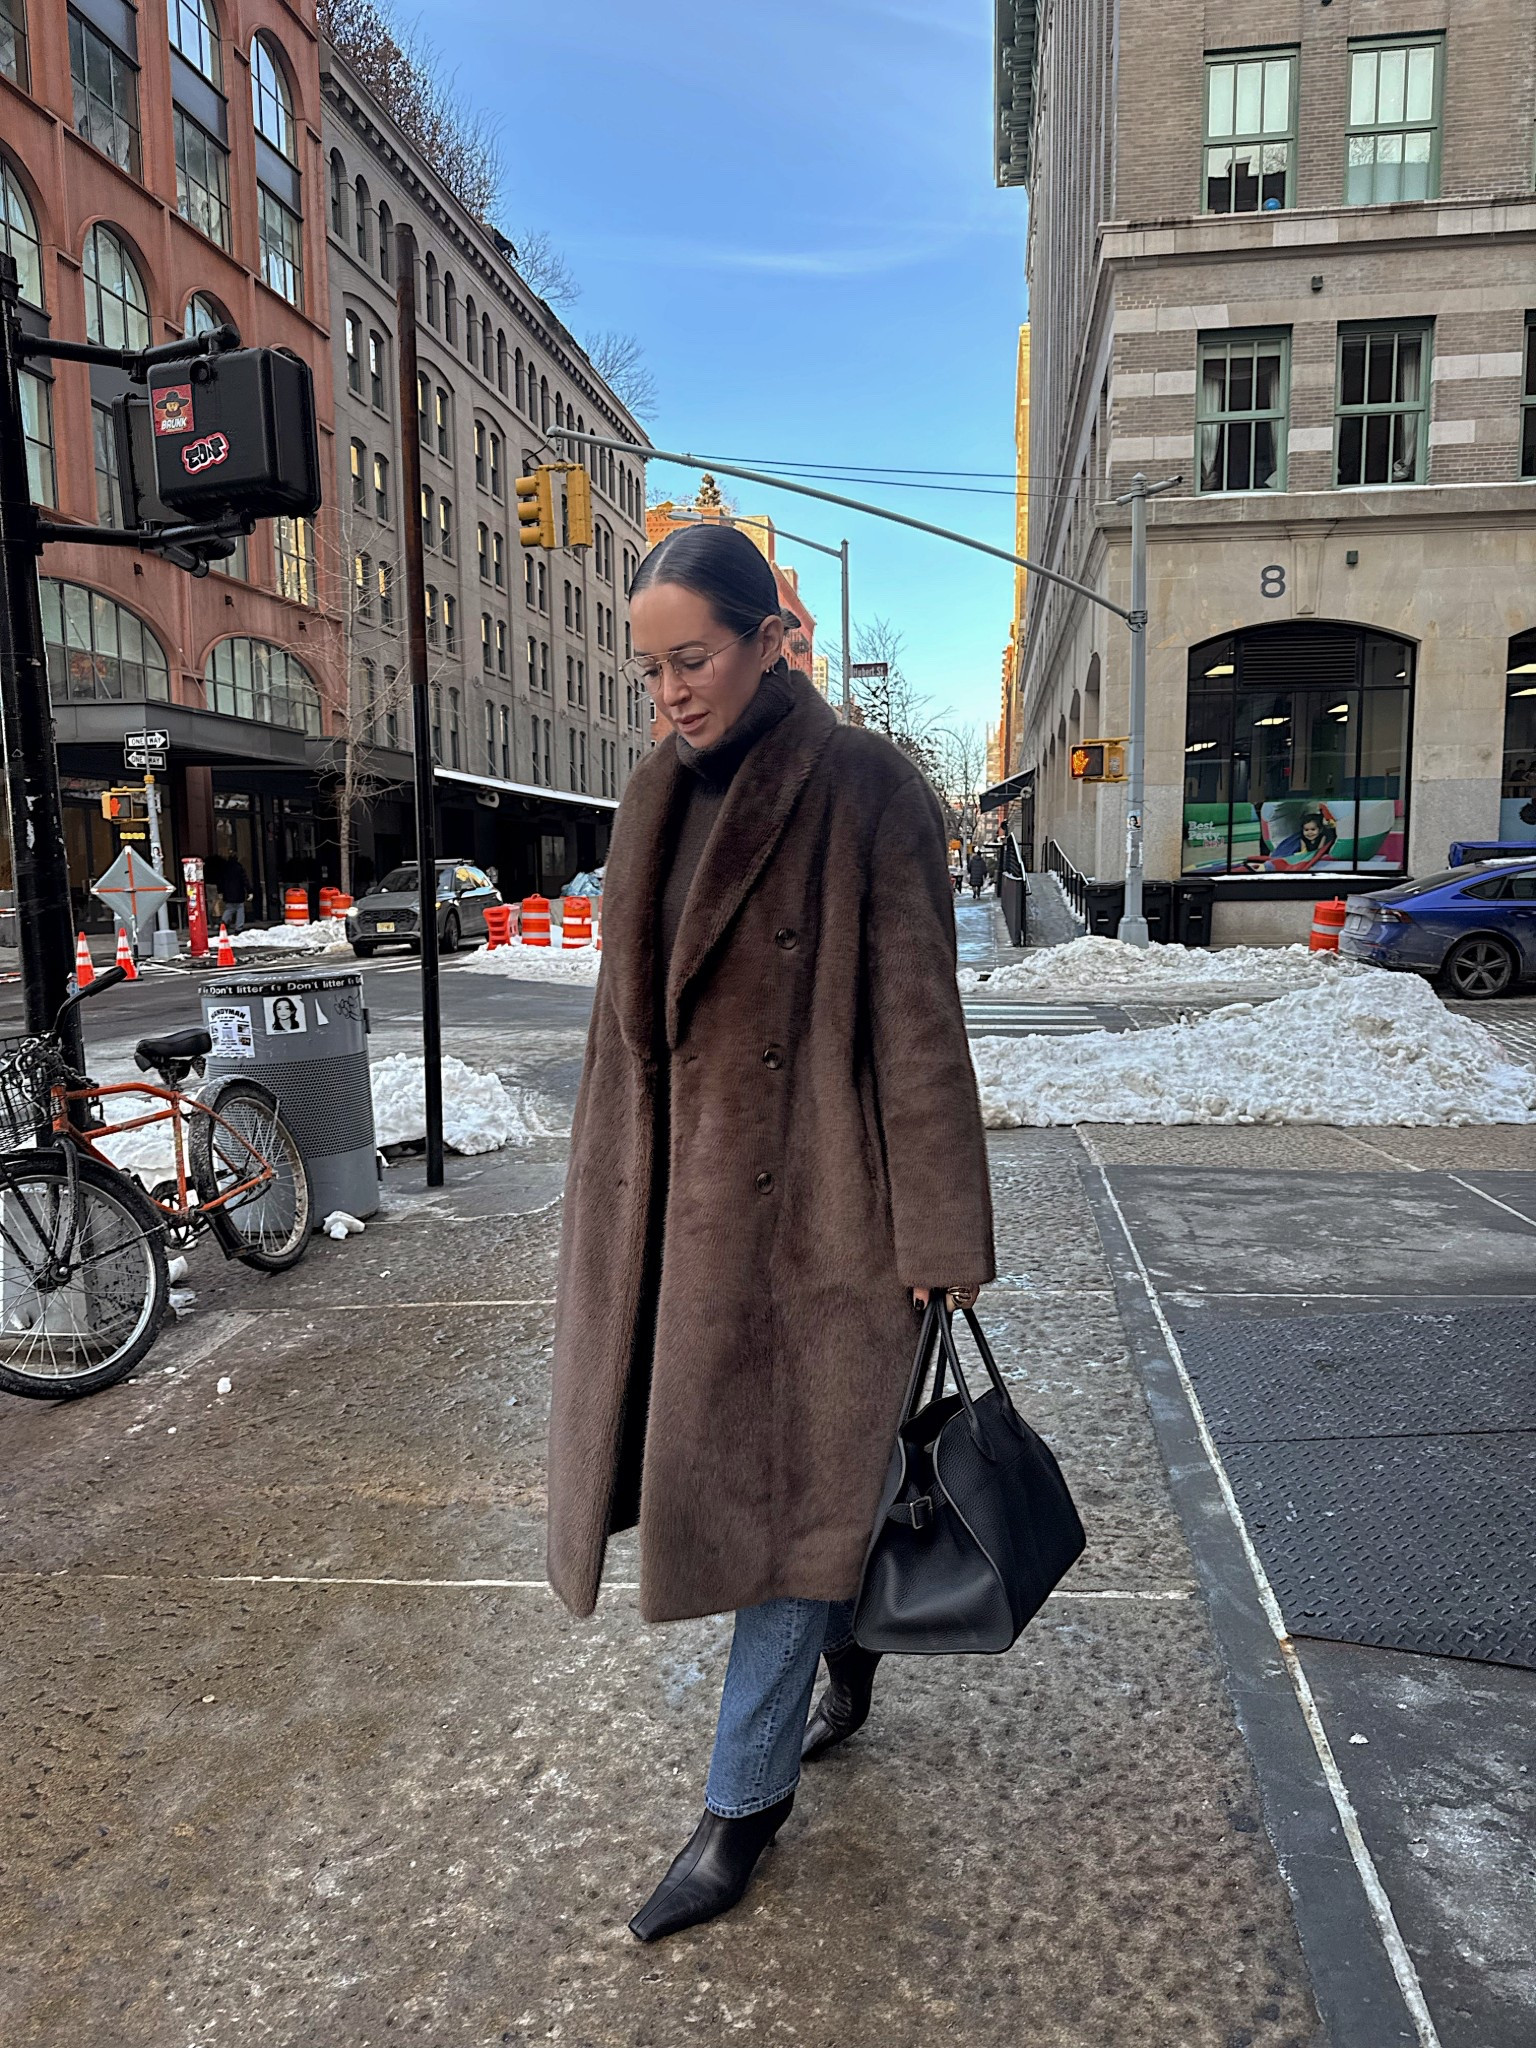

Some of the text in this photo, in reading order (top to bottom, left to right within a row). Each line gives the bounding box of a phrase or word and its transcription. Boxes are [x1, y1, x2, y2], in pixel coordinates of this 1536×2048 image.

[1261, 565, 1286, 598] 8
[854, 666, 884, 677] Hubert St
[1188, 821, 1215, 830] Best
[210, 985, 233, 995] Don't
[236, 985, 264, 994] litter
[287, 982, 319, 991] Don't
[322, 980, 345, 988] litter
